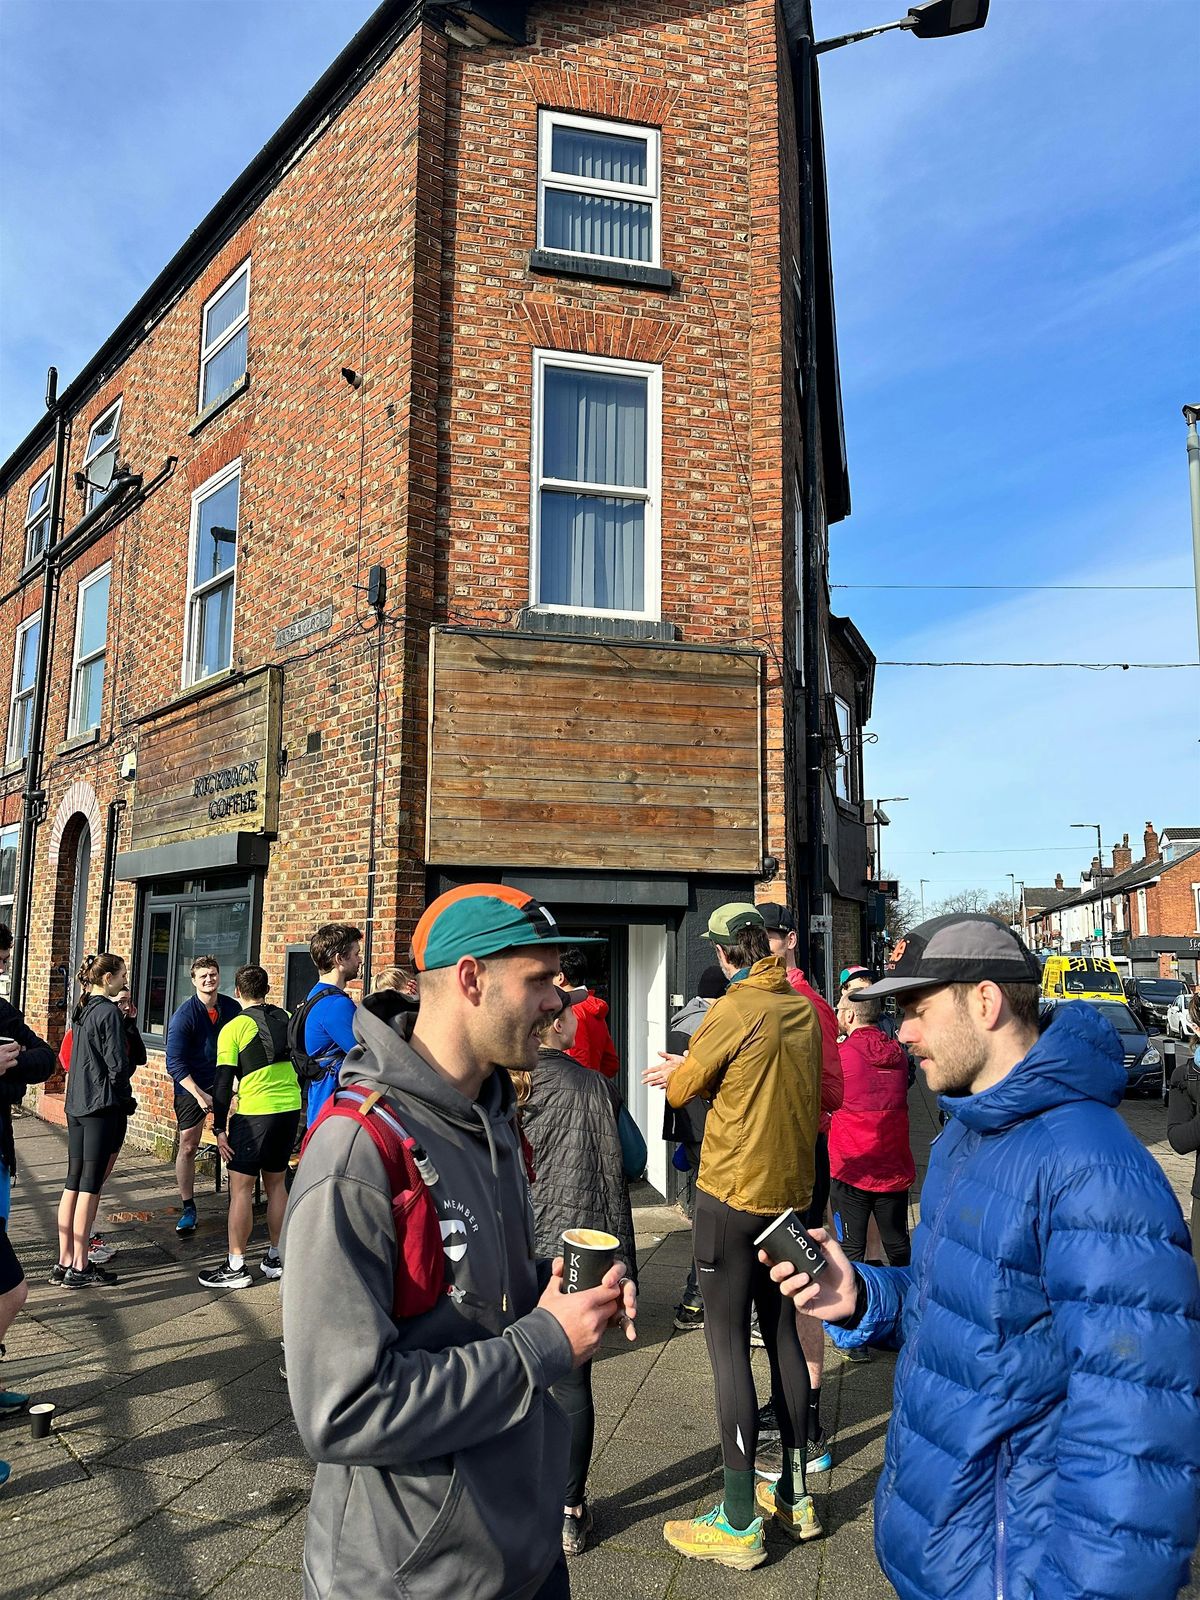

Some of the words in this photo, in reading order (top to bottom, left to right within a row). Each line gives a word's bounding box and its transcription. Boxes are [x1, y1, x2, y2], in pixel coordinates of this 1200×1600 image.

[193, 760, 258, 798] KICKBACK
[208, 789, 258, 820] COFFEE
[443, 1199, 479, 1233] MEMBER
[787, 1222, 817, 1261] KBC
[695, 1531, 724, 1543] HOKA
